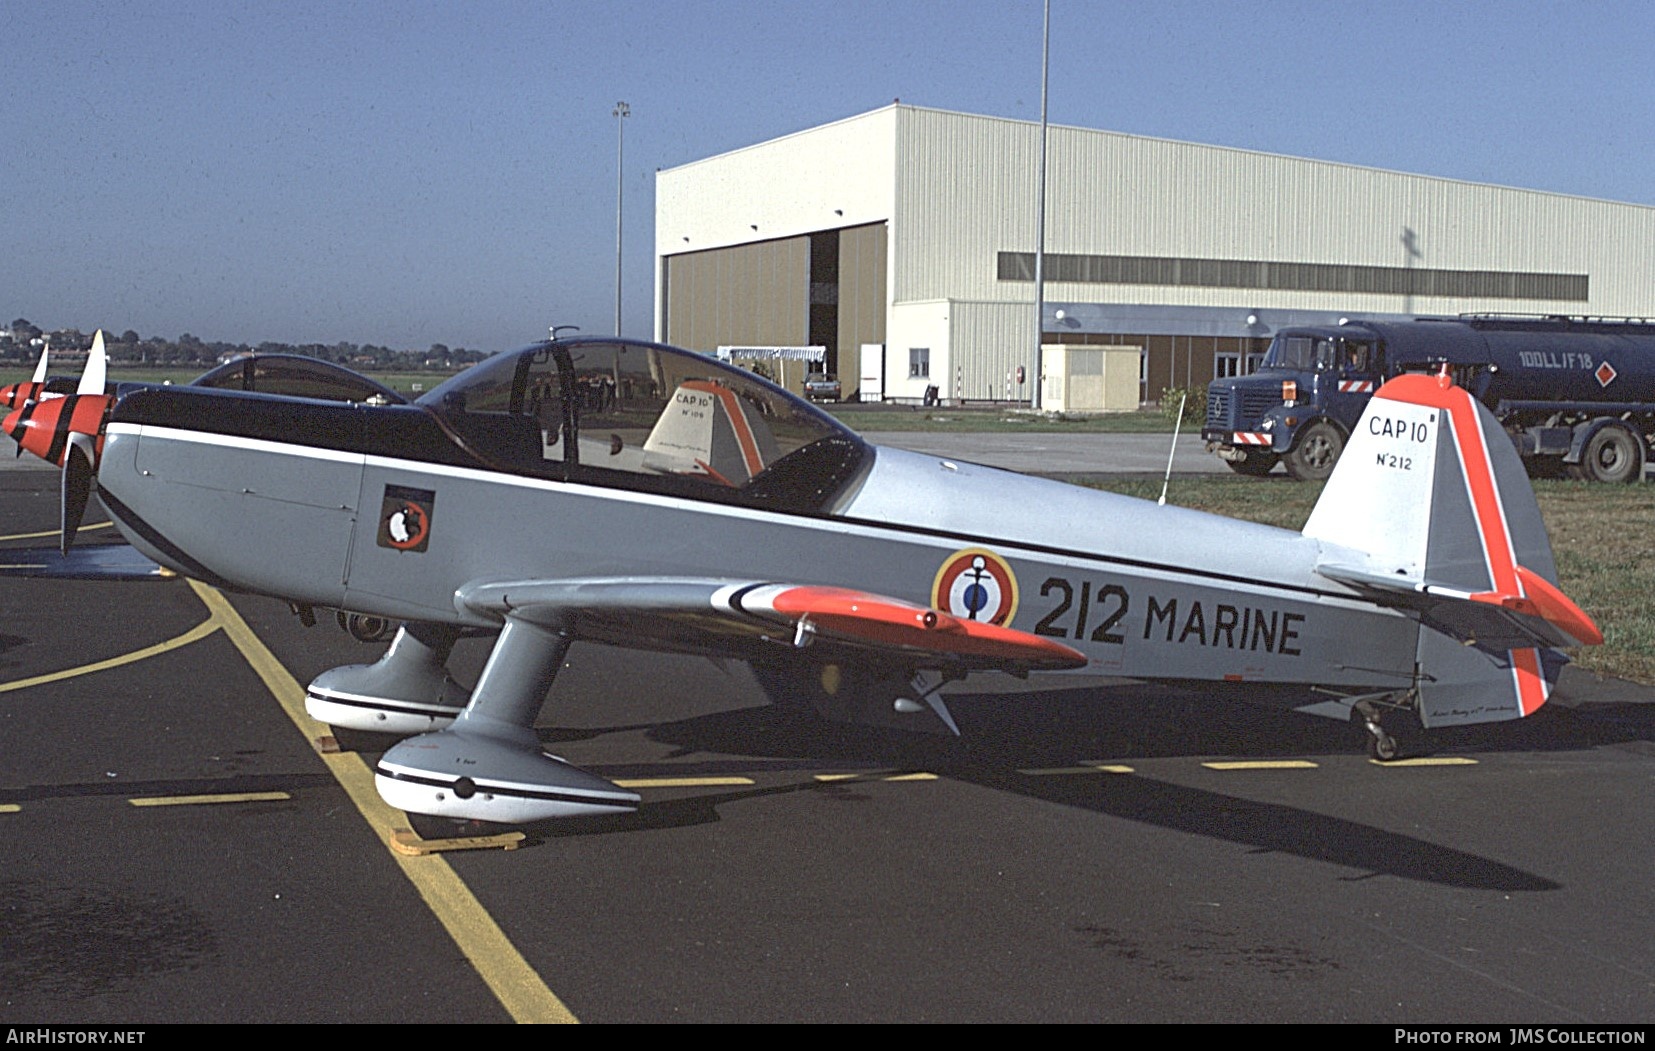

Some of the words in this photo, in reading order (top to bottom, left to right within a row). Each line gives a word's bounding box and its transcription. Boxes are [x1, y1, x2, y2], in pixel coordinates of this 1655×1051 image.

[676, 393, 696, 405] CAP
[1369, 415, 1407, 439] CAP
[1034, 577, 1130, 645] 212
[1142, 595, 1306, 657] MARINE
